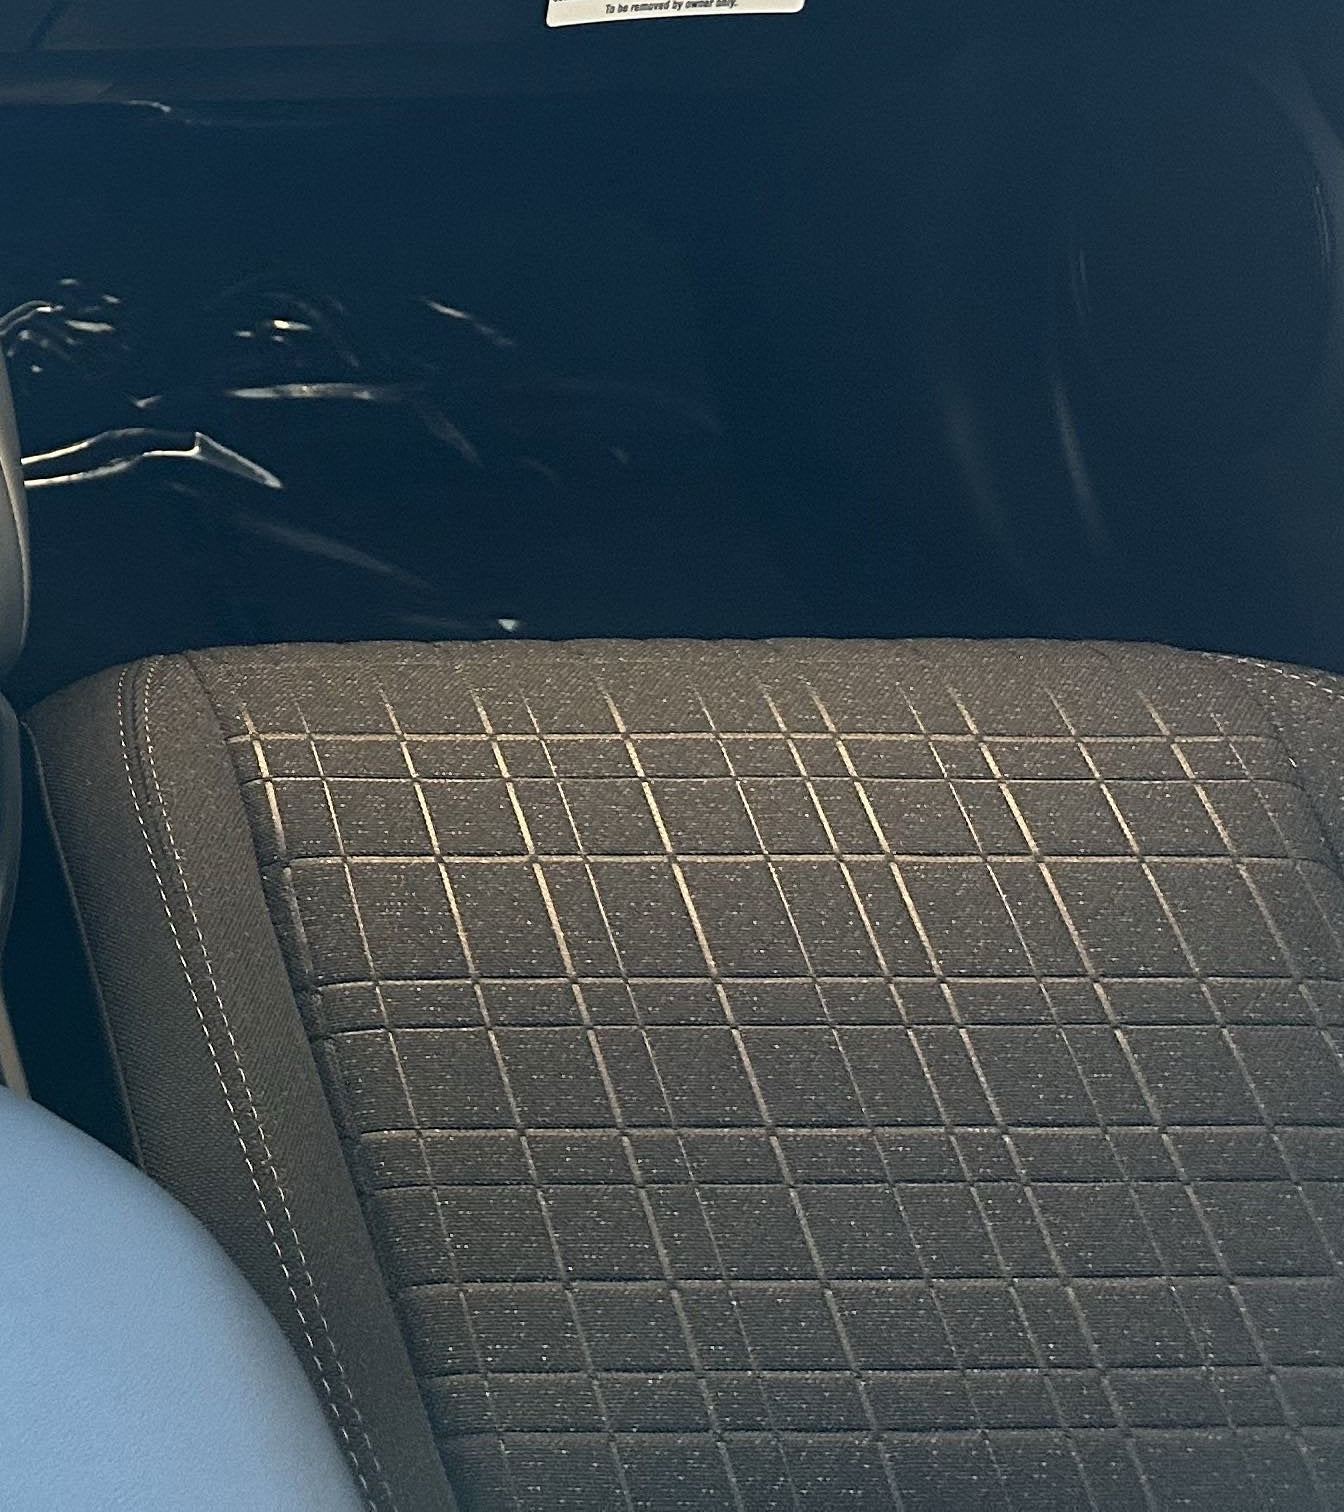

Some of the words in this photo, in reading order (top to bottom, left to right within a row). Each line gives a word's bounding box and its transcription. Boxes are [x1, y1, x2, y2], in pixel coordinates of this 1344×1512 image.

[605, 4, 615, 14] To
[617, 3, 629, 13] be
[631, 0, 671, 11] removed
[672, 0, 683, 11] by
[685, 0, 713, 8] owner
